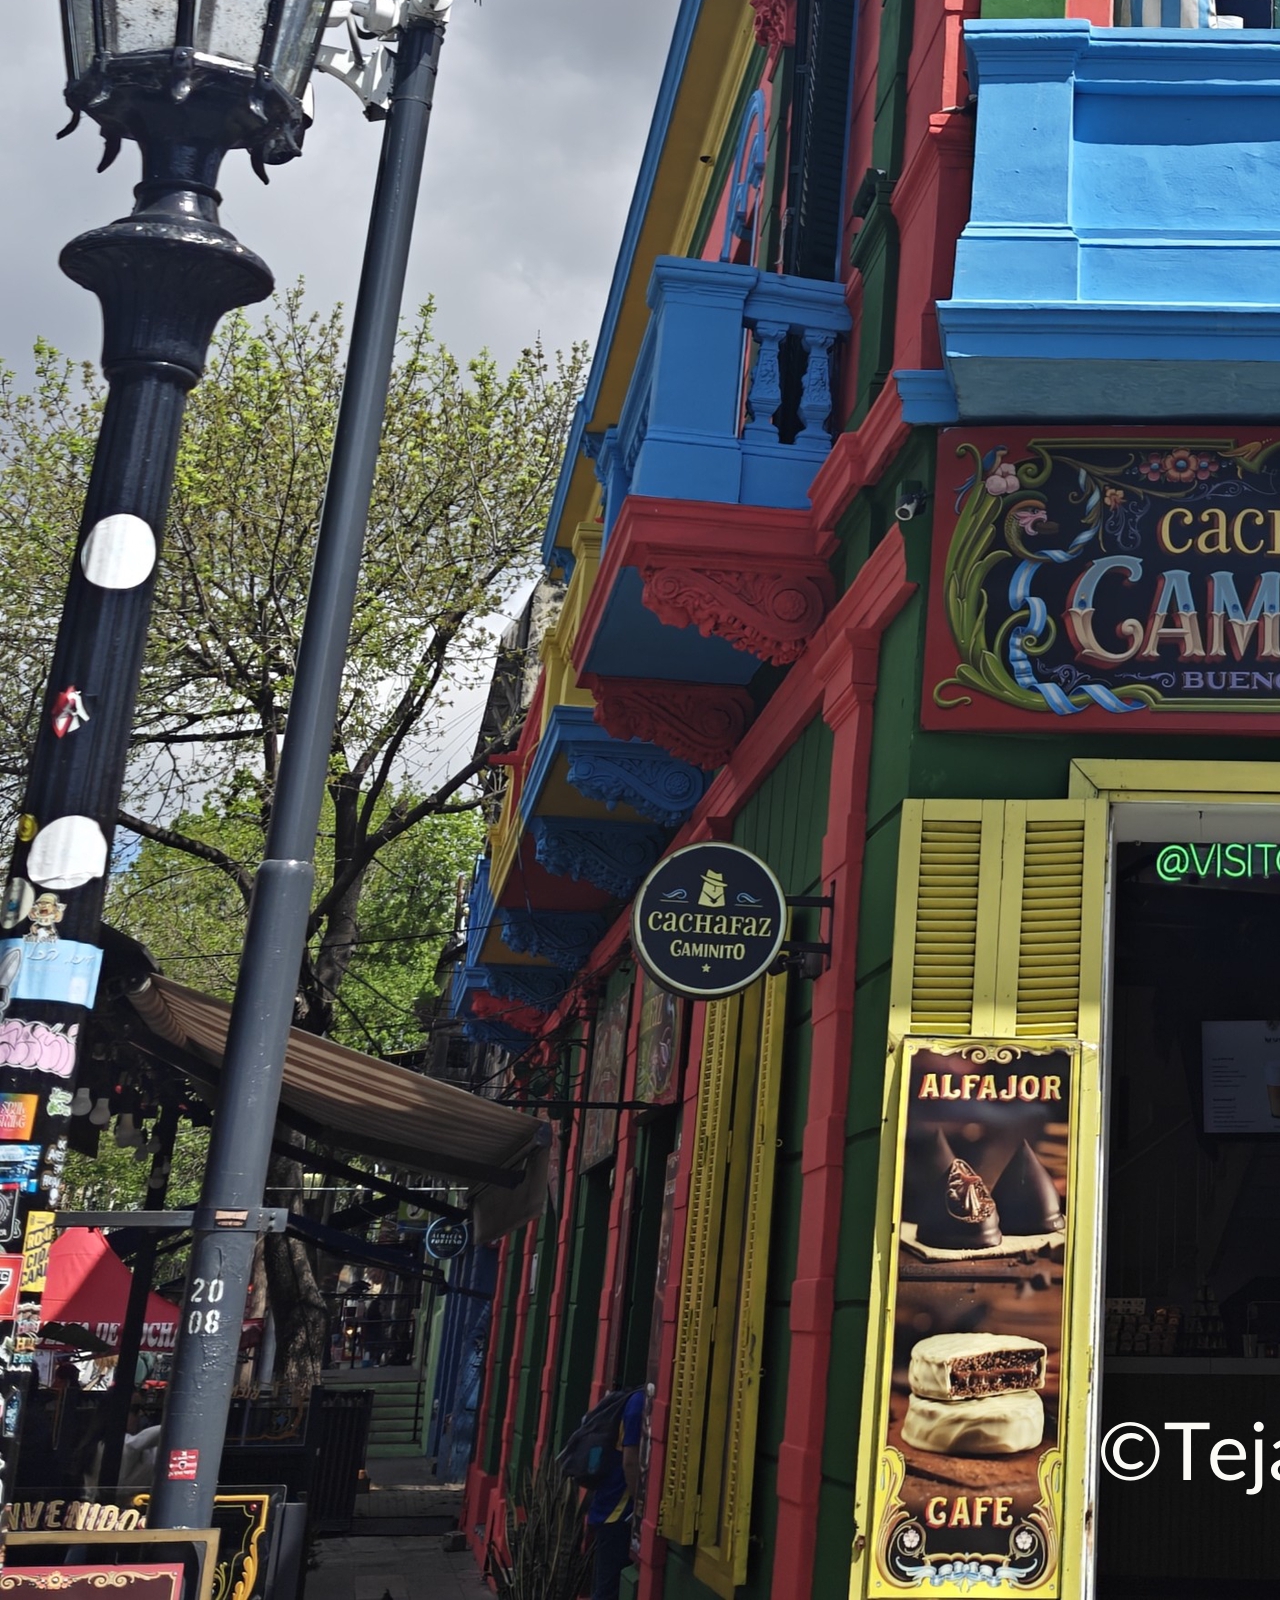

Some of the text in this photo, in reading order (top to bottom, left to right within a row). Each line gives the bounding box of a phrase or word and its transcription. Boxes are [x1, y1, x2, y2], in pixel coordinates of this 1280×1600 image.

[669, 939, 746, 961] CAMINITO
[918, 1073, 1062, 1101] ALFAJOR
[190, 1278, 224, 1303] 20
[188, 1309, 220, 1335] 08
[925, 1496, 1013, 1528] CAFE
